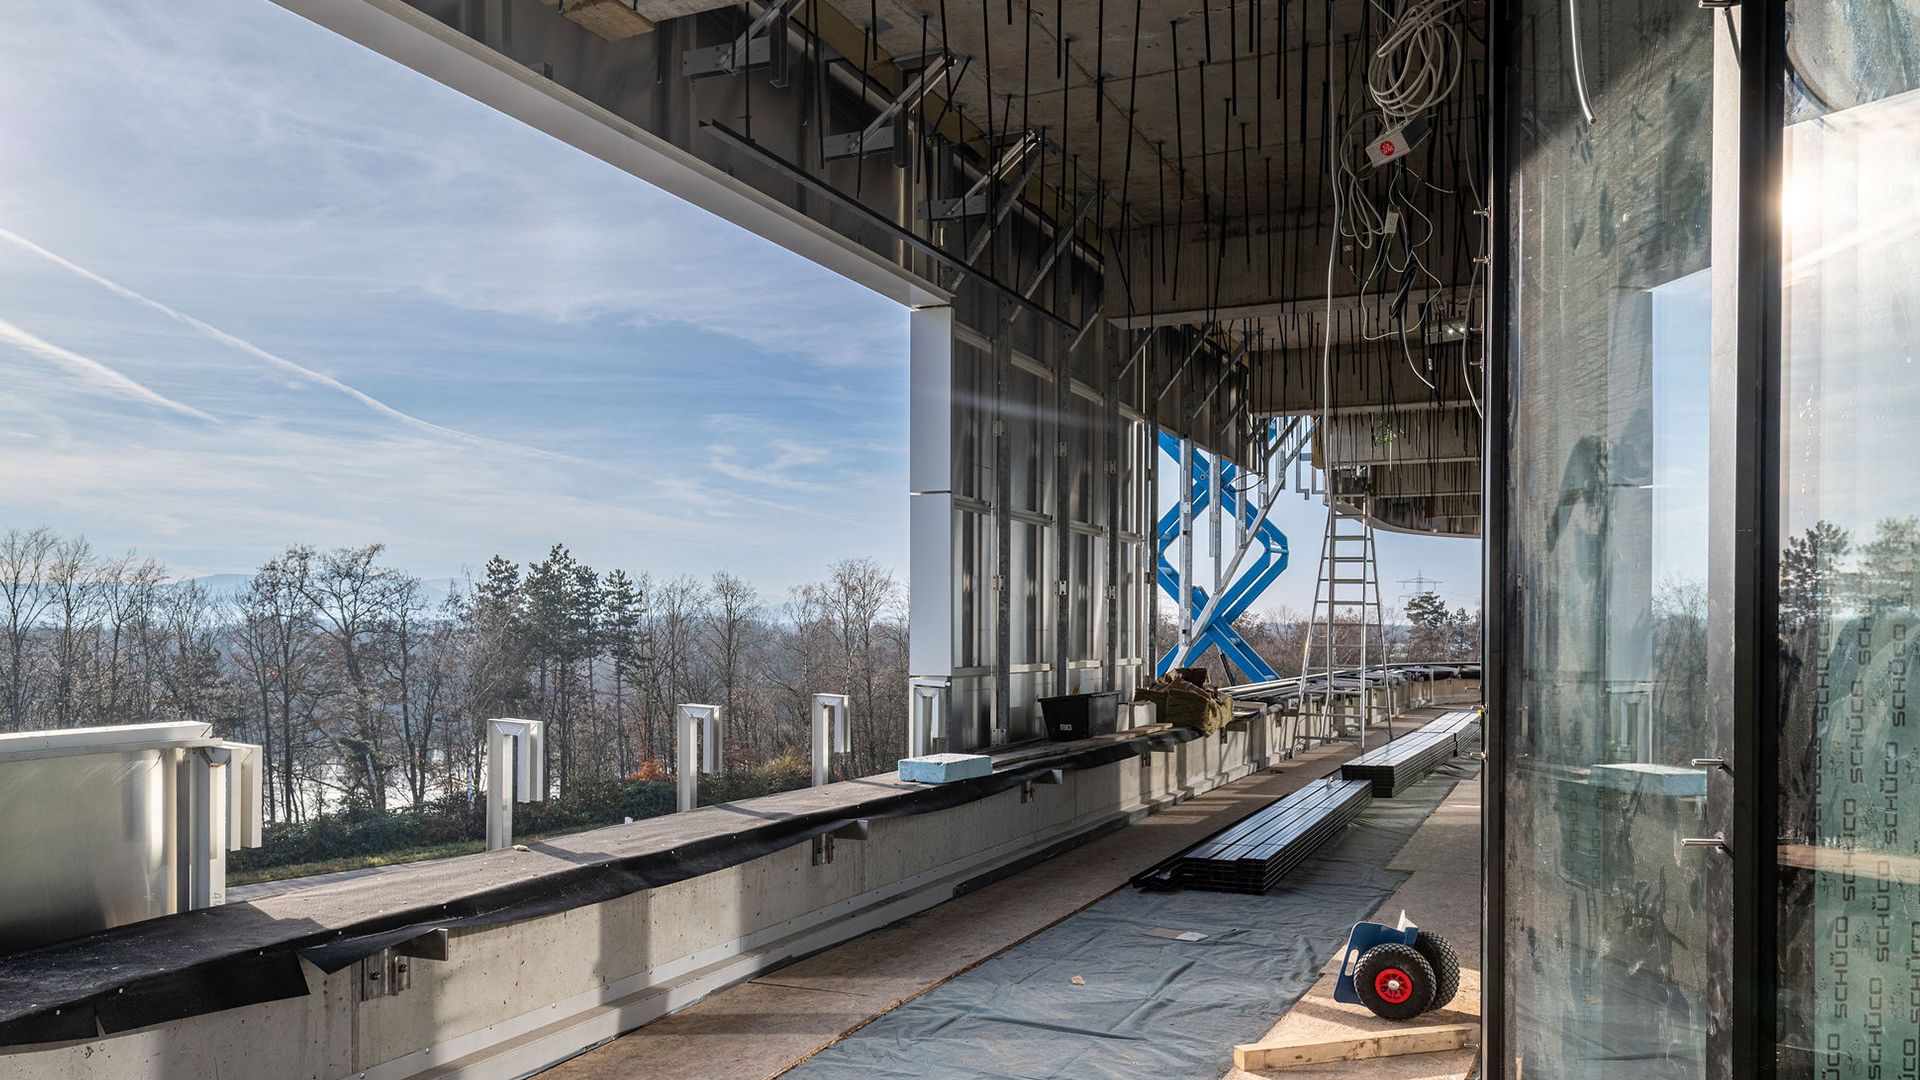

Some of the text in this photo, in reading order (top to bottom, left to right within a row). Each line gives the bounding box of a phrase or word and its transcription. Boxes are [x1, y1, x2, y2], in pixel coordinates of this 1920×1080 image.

[1829, 916, 1848, 1019] SCHÜCO
[1845, 681, 1864, 784] SCHÜCO
[1863, 623, 1906, 1080] SCHÜCO SCHÜCO SCHÜCO SCHÜCO
